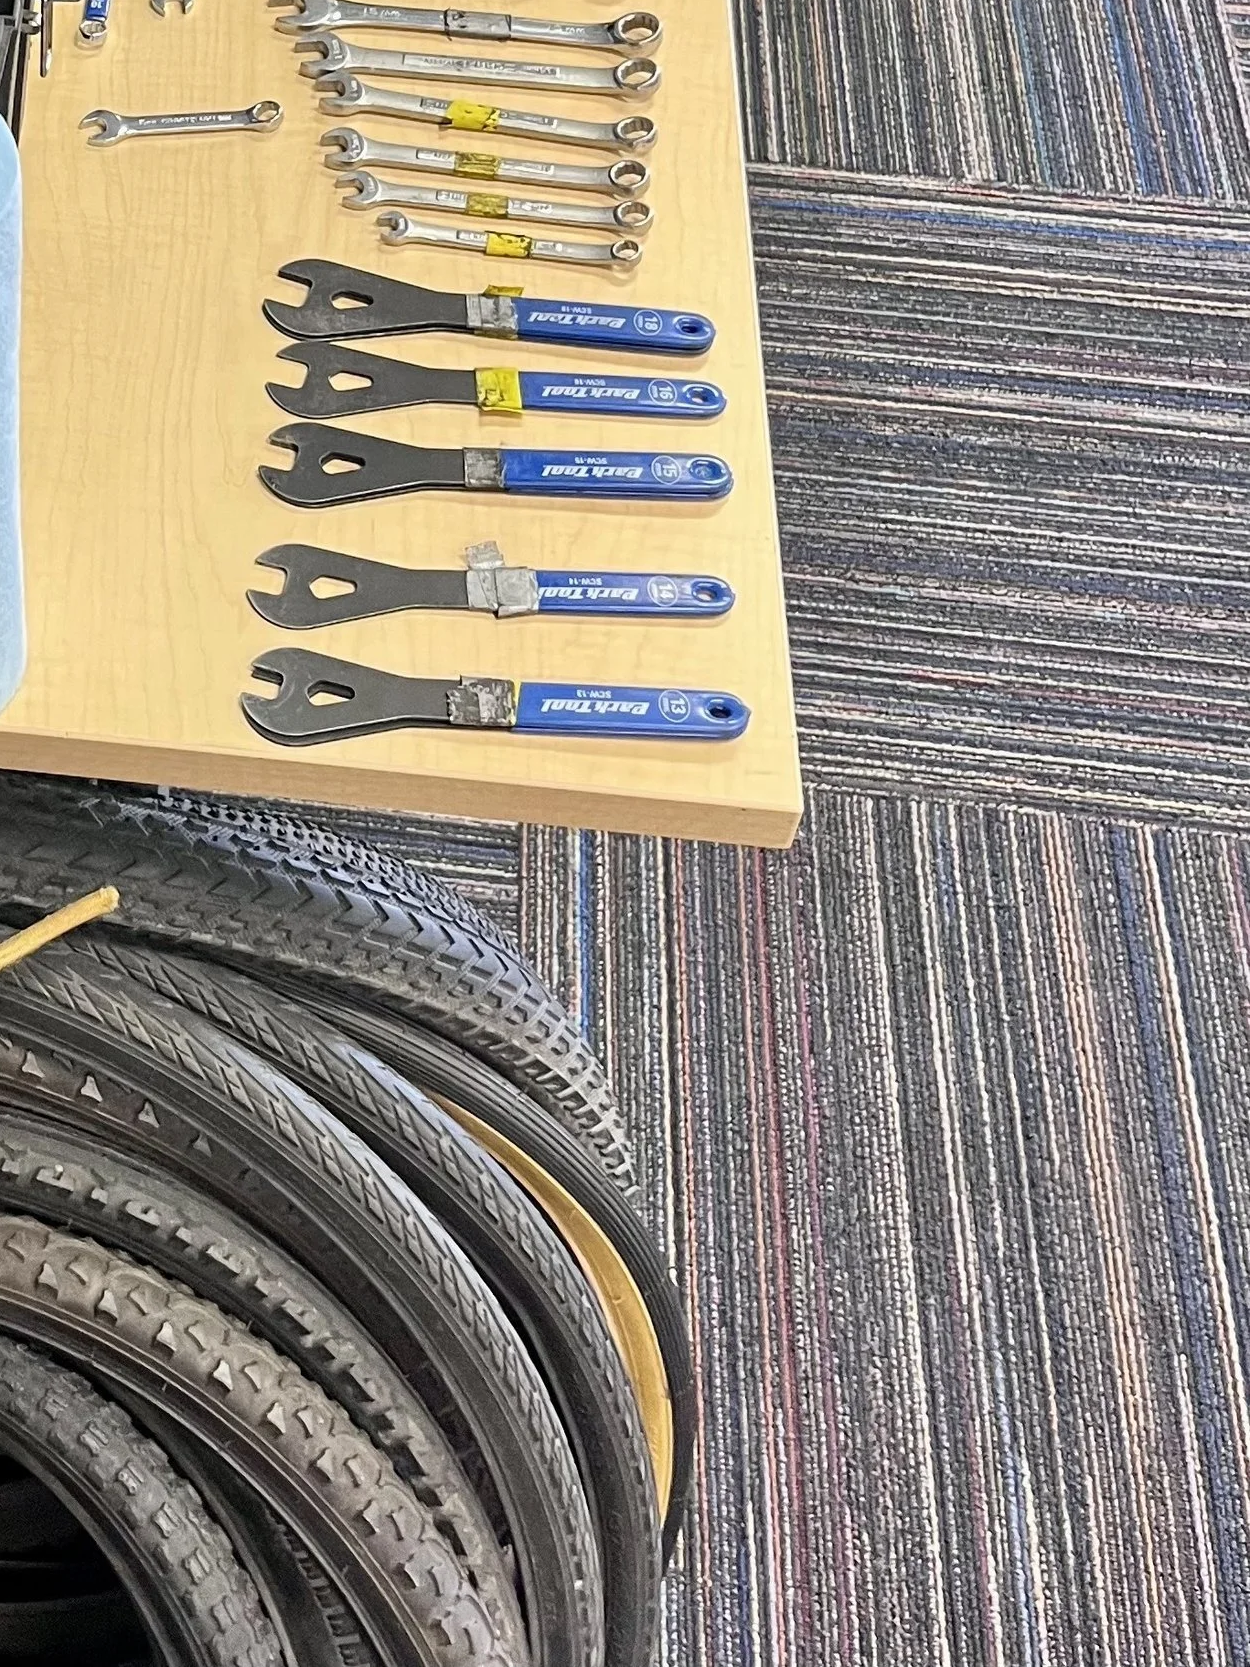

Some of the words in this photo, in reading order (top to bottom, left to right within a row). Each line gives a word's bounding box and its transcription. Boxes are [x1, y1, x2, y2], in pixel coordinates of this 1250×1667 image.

[644, 316, 658, 330] 18
[658, 386, 673, 400] 16
[662, 464, 678, 478] 15
[659, 584, 674, 600] 14
[670, 698, 687, 714] 13
